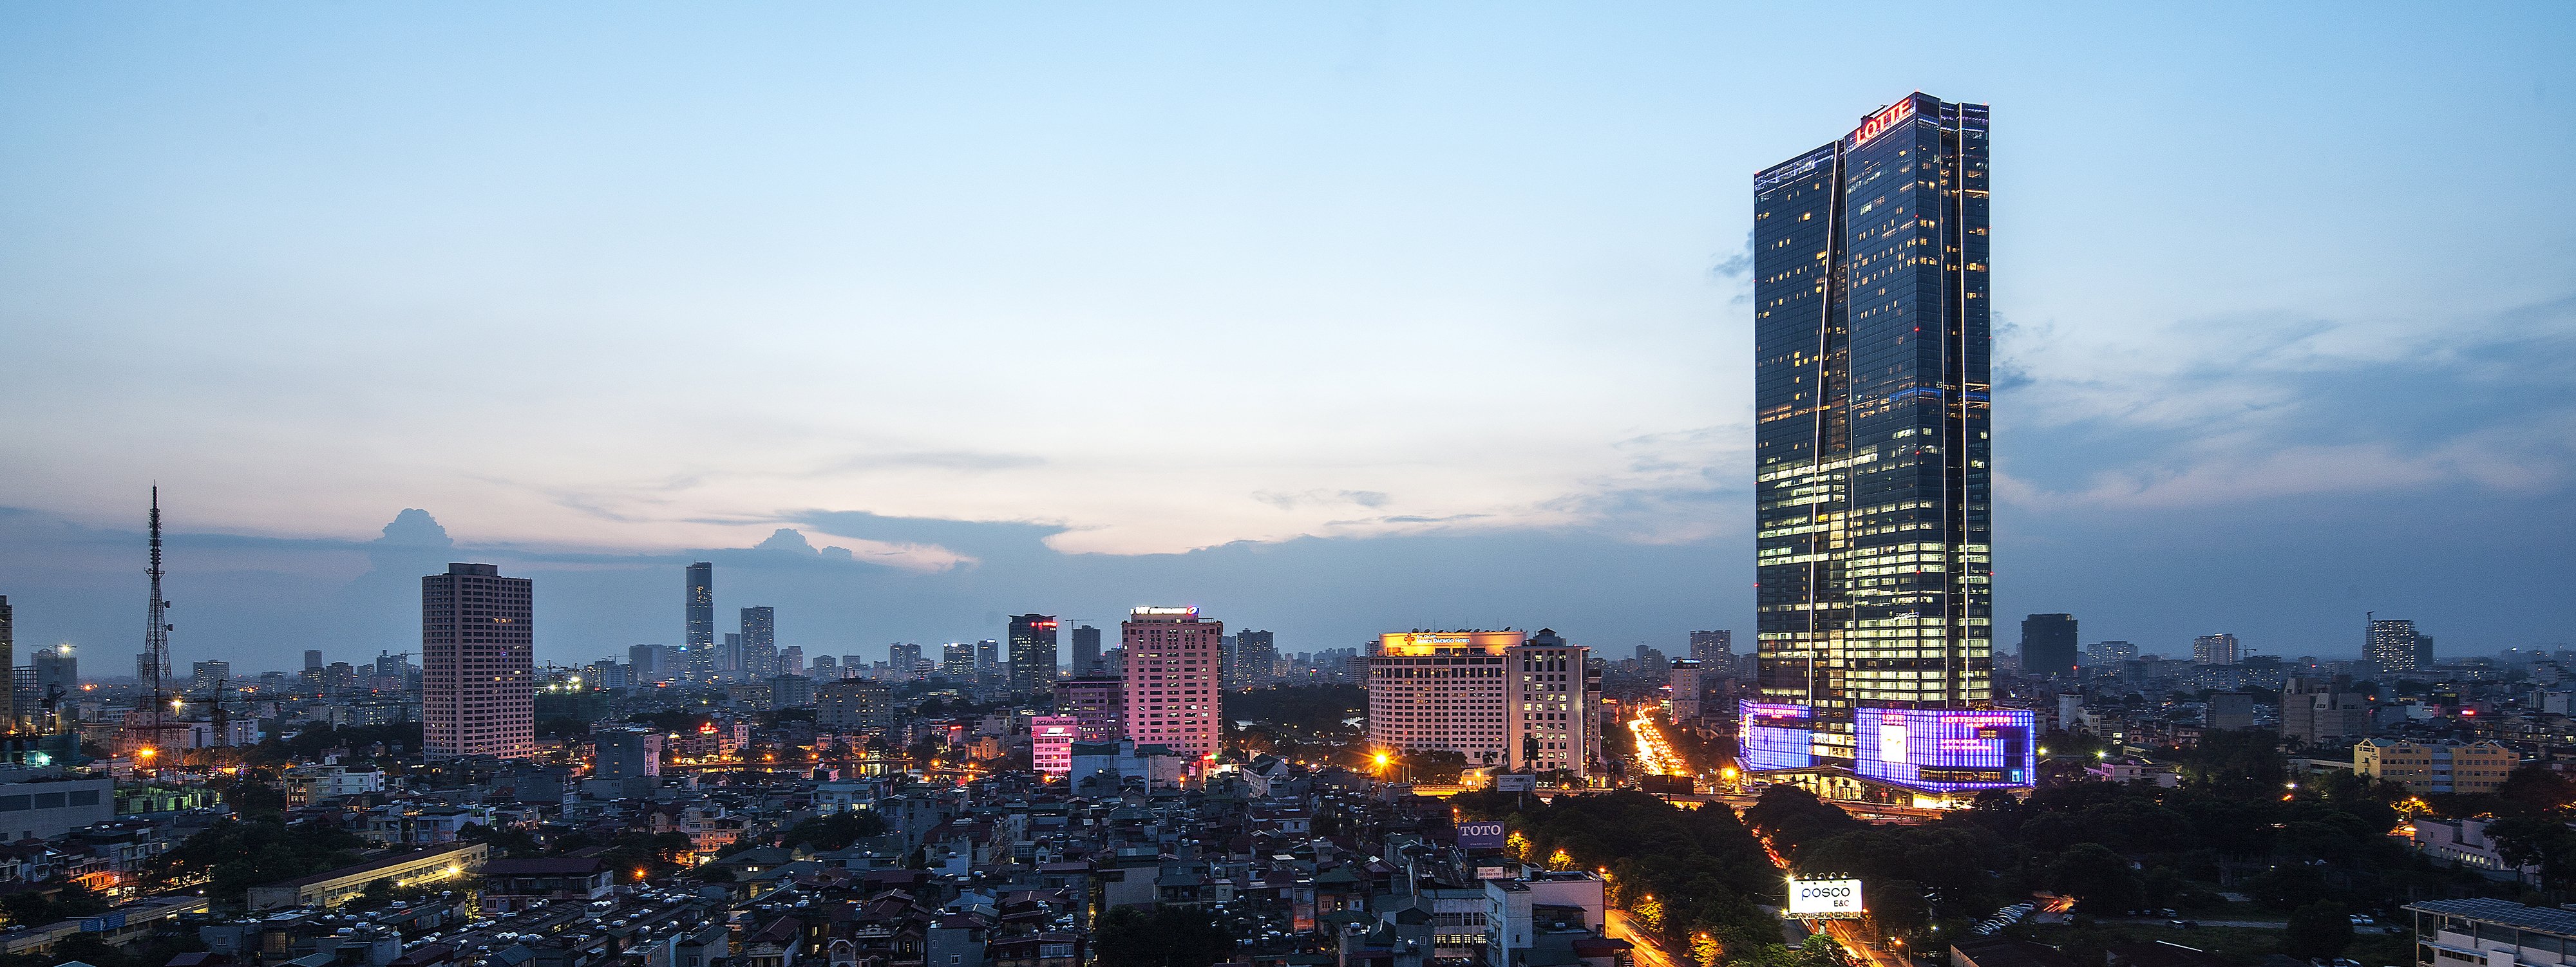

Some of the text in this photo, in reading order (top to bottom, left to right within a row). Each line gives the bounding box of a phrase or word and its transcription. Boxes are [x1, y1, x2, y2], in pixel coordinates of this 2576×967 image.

[1856, 99, 1910, 146] LOTTE
[1460, 825, 1501, 836] TOTO
[1801, 887, 1850, 901] posco
